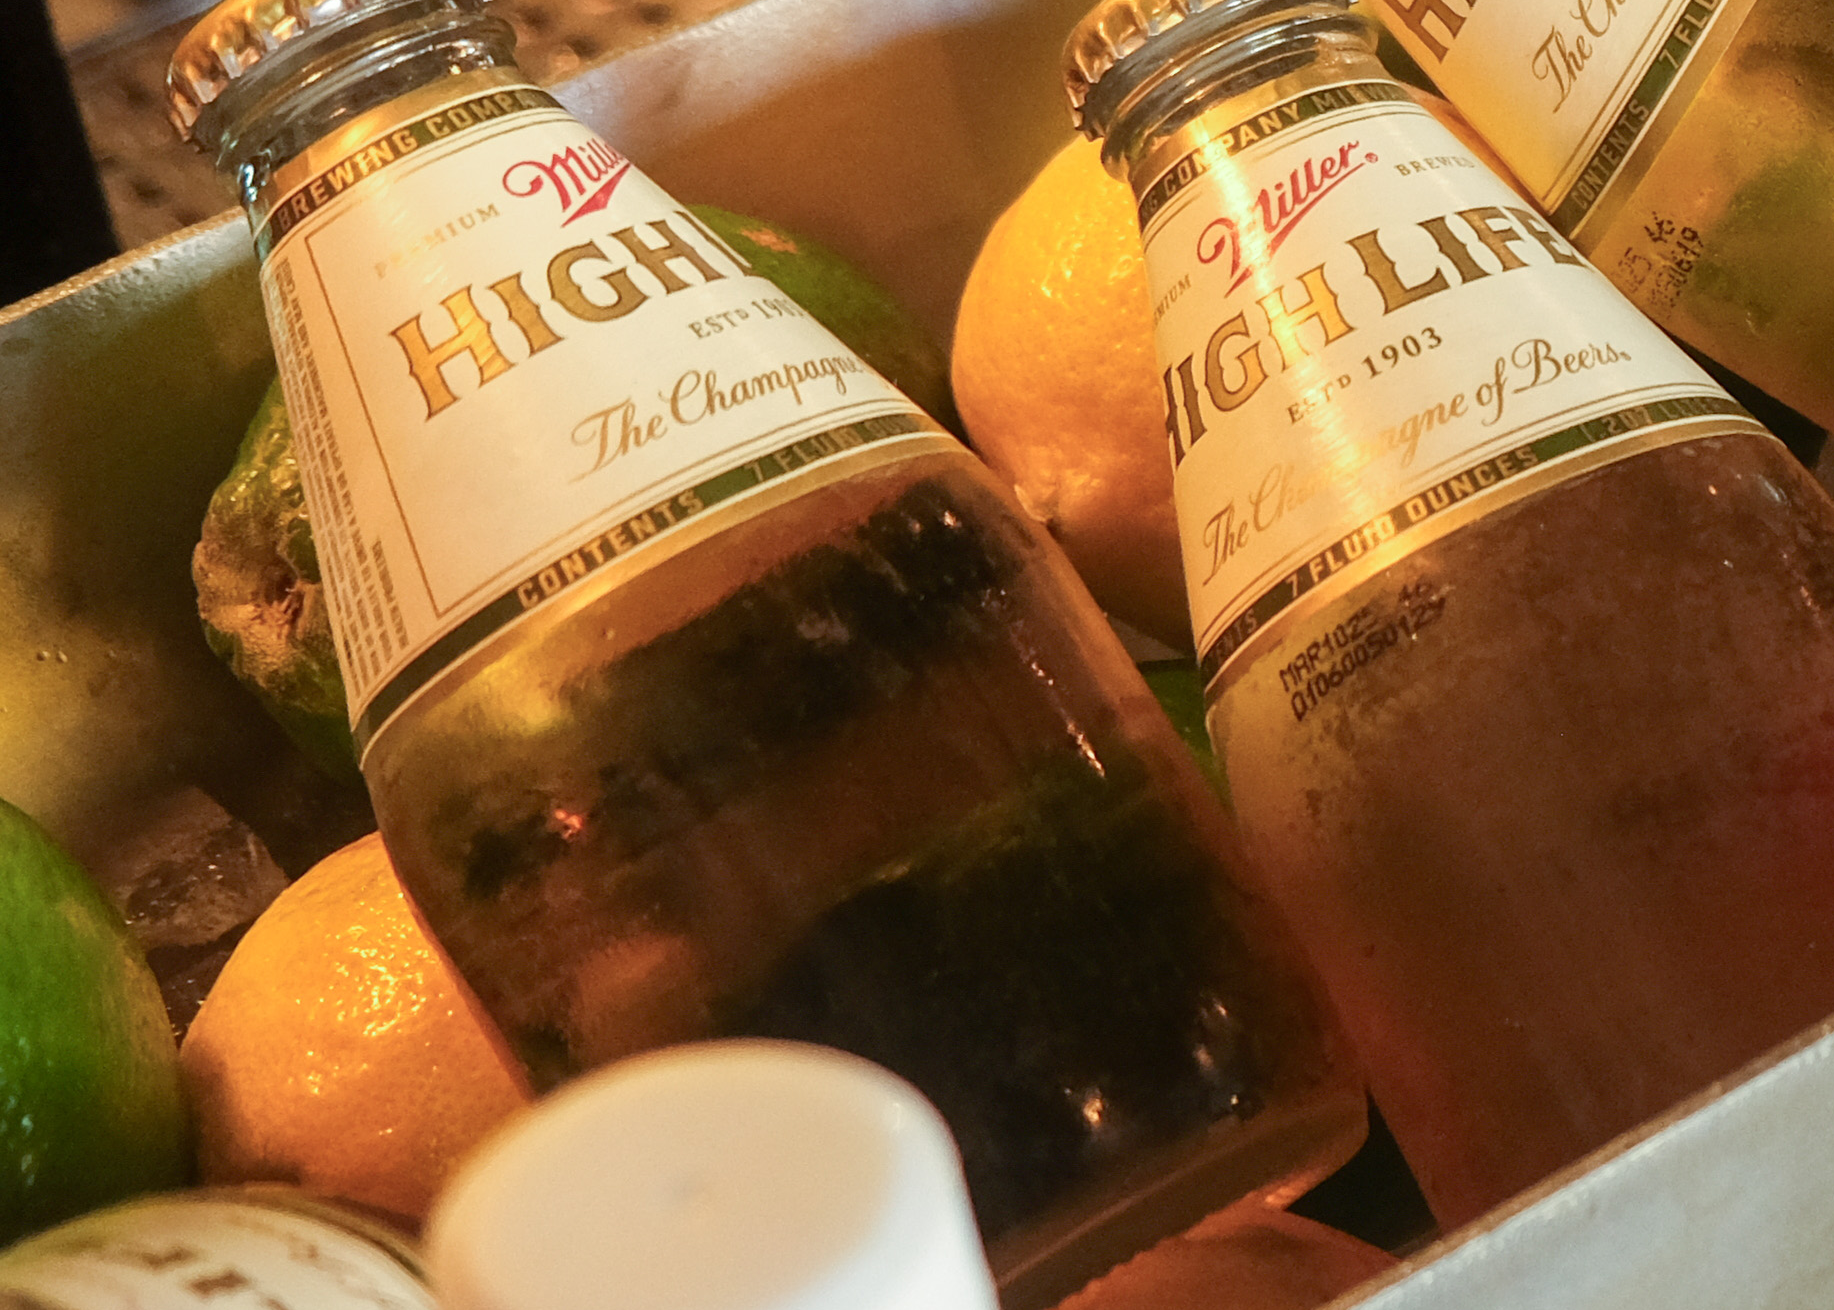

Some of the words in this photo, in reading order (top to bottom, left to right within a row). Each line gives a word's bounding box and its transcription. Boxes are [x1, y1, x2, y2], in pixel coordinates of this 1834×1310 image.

[1531, 25, 1594, 114] The
[1570, 101, 1649, 212] CONTENTS
[1658, 50, 1679, 72] 7
[275, 125, 419, 228] BREWING
[1197, 140, 1361, 284] Miller
[387, 224, 726, 421] HIGH
[1346, 205, 1587, 316] LIFE
[1362, 325, 1444, 381] 1903
[570, 396, 665, 480] The
[1202, 498, 1251, 587] The
[1474, 370, 1508, 430] of
[517, 491, 706, 609] CONTENTS
[744, 458, 769, 485] 7
[769, 425, 869, 478] FLUID
[1285, 568, 1303, 601] 7
[1308, 513, 1397, 583] FLUID
[1404, 445, 1541, 522] OUNCES
